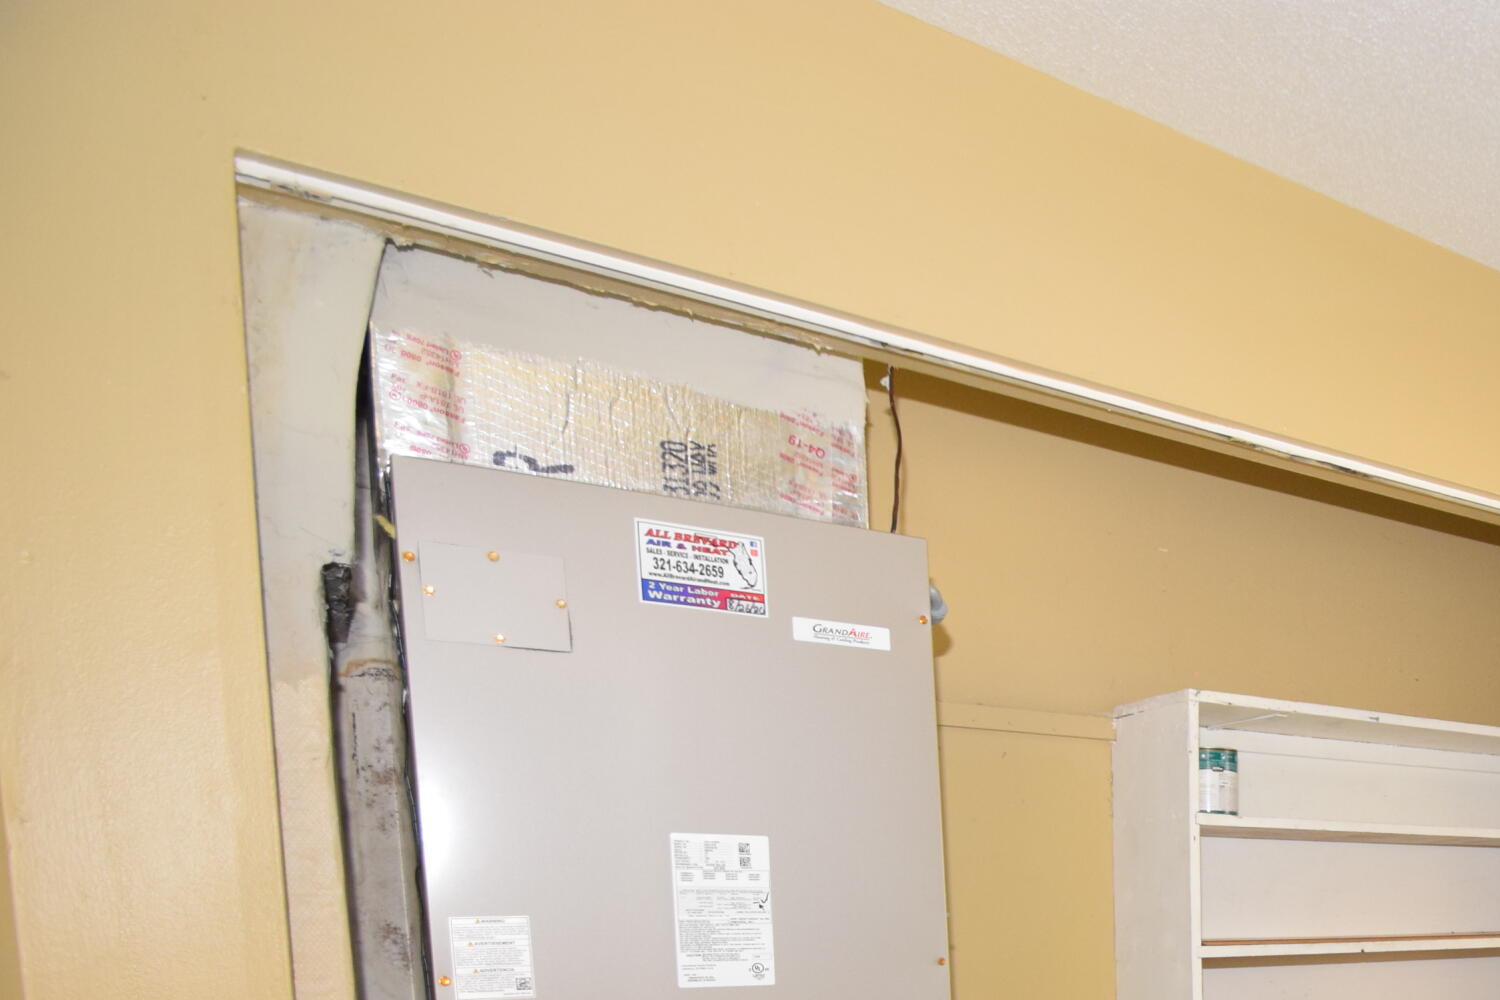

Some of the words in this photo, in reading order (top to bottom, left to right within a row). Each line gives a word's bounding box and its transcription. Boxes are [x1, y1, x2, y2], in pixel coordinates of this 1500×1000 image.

[645, 528, 671, 540] ALL
[646, 539, 672, 548] AIR
[653, 557, 724, 578] 321-634-2659
[648, 581, 656, 589] 2
[659, 582, 684, 593] Year
[687, 586, 719, 597] Labor
[647, 590, 721, 608] Warranty
